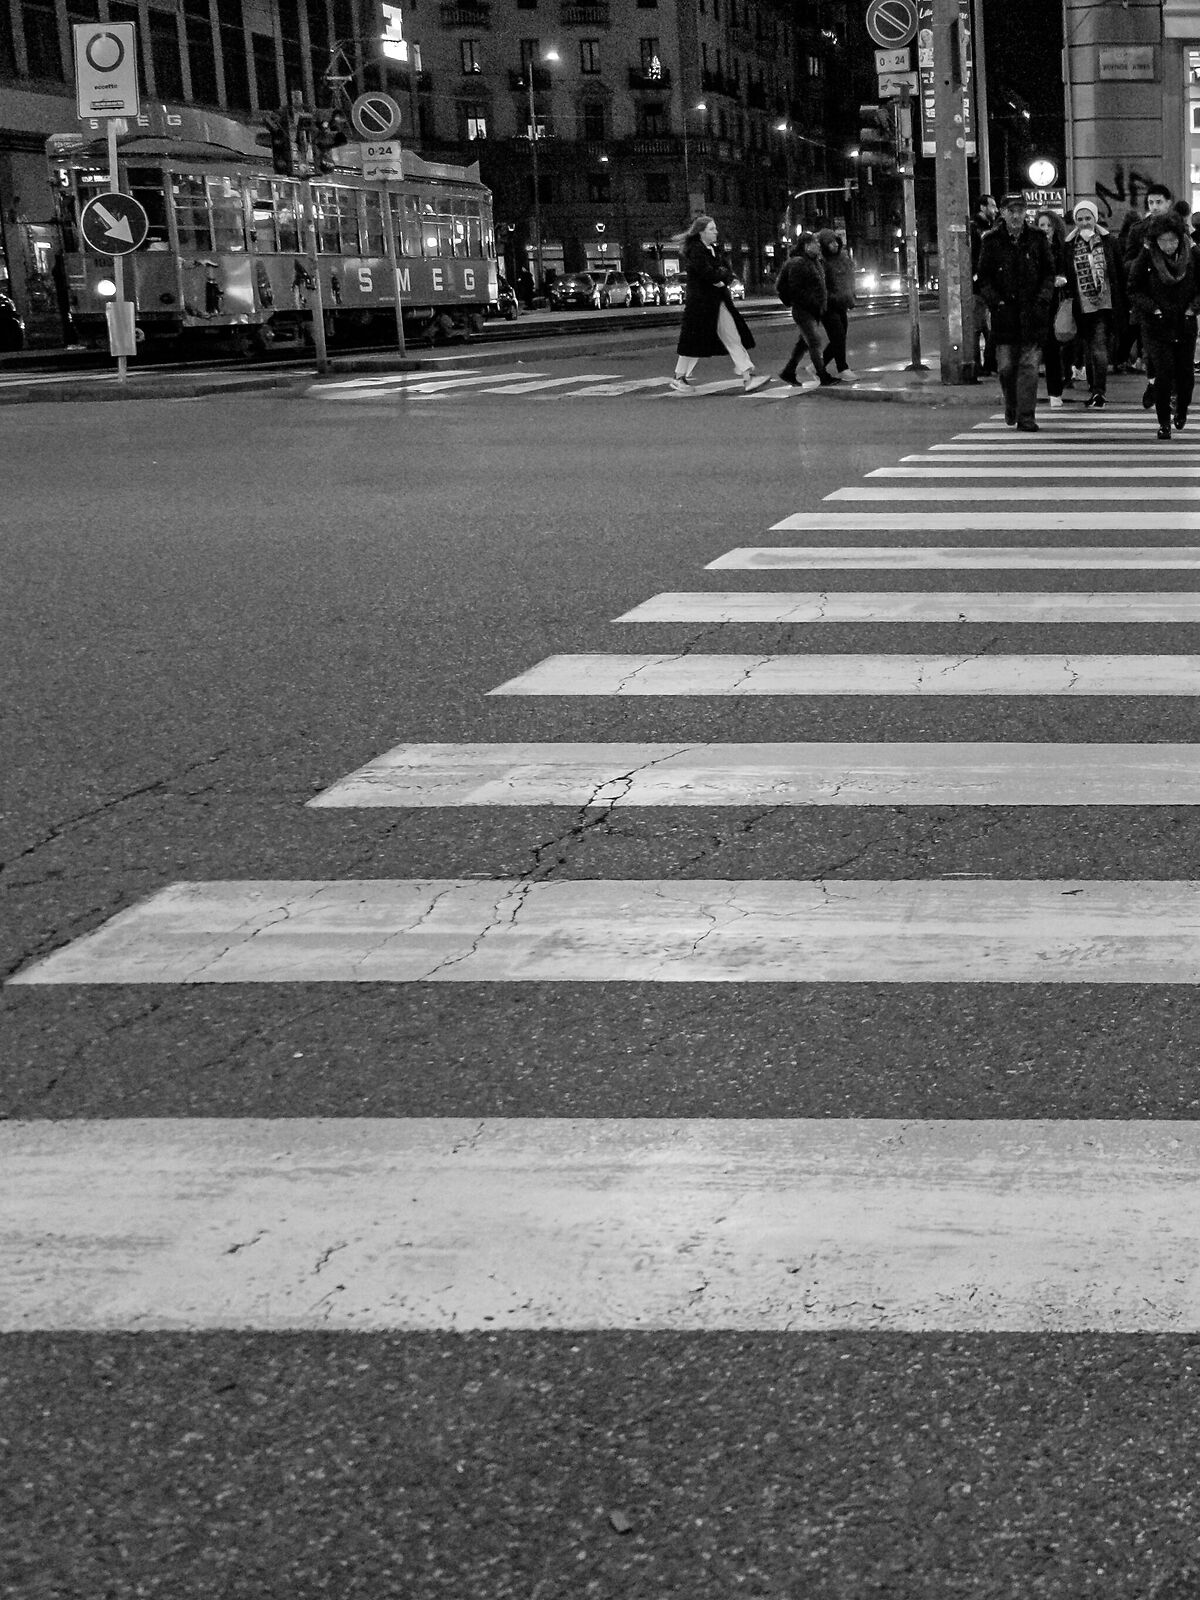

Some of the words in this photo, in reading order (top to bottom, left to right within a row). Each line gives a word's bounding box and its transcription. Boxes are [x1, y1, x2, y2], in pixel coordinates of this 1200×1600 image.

[894, 55, 905, 65] 24
[90, 115, 182, 130] SEG
[59, 168, 70, 187] 5
[1025, 191, 1063, 201] MOTTA
[358, 267, 476, 293] SMEG
